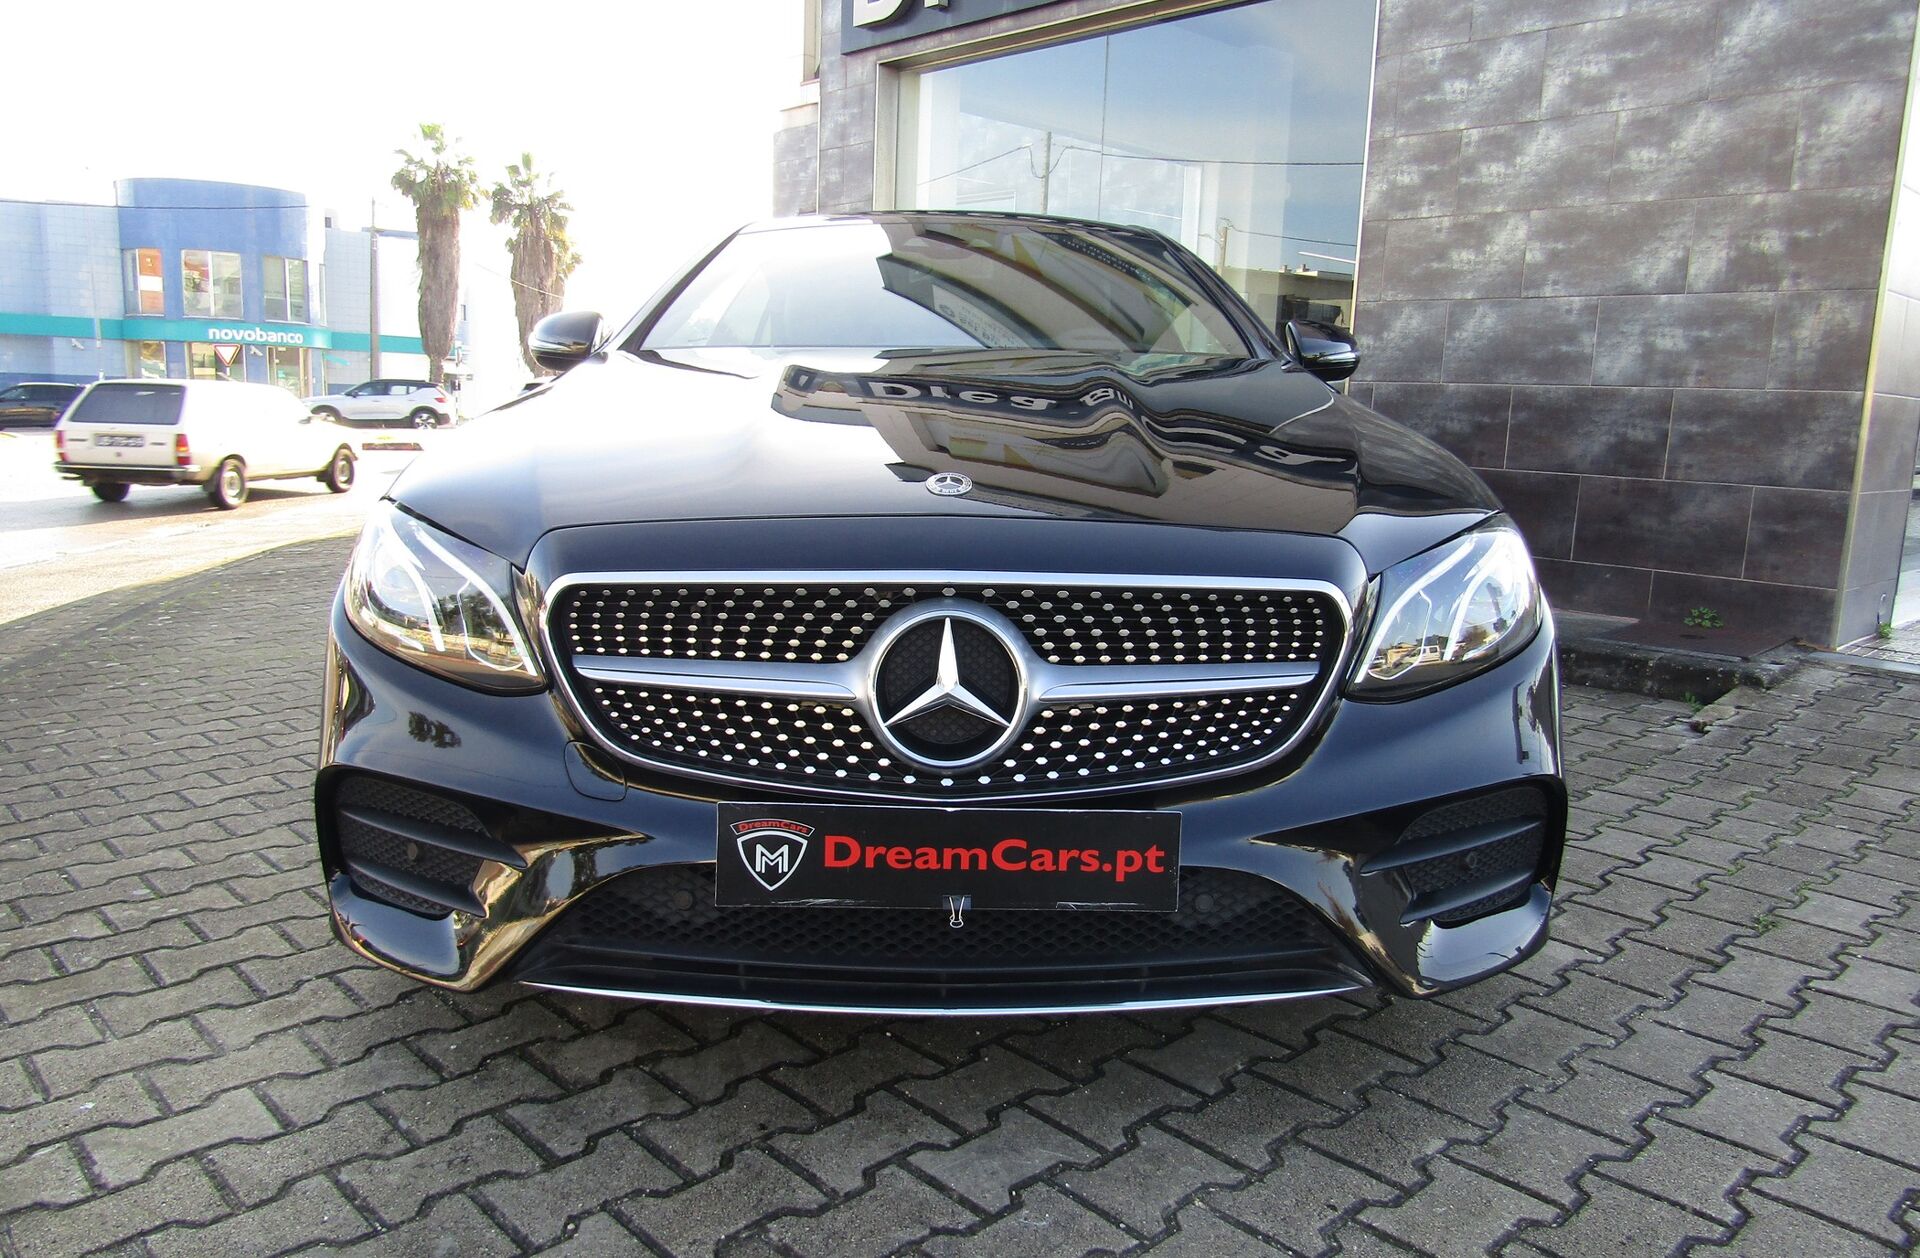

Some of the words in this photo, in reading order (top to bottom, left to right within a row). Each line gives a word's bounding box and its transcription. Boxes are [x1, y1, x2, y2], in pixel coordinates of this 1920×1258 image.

[207, 327, 304, 345] novobanco
[738, 820, 808, 833] DreamCars
[824, 834, 1165, 883] DreamCars.pt
